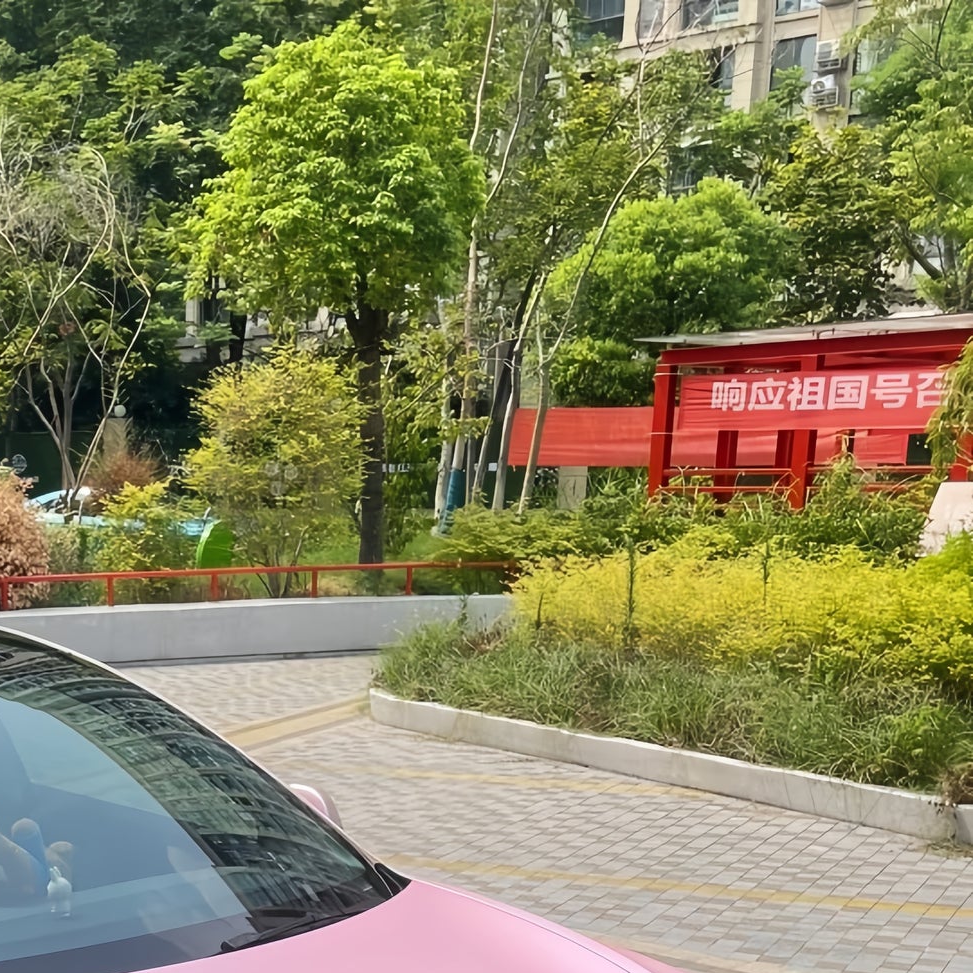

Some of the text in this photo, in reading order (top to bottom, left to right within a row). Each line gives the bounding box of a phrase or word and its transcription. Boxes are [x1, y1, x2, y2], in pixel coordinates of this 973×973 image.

[711, 372, 949, 411] 响应祖国号召
